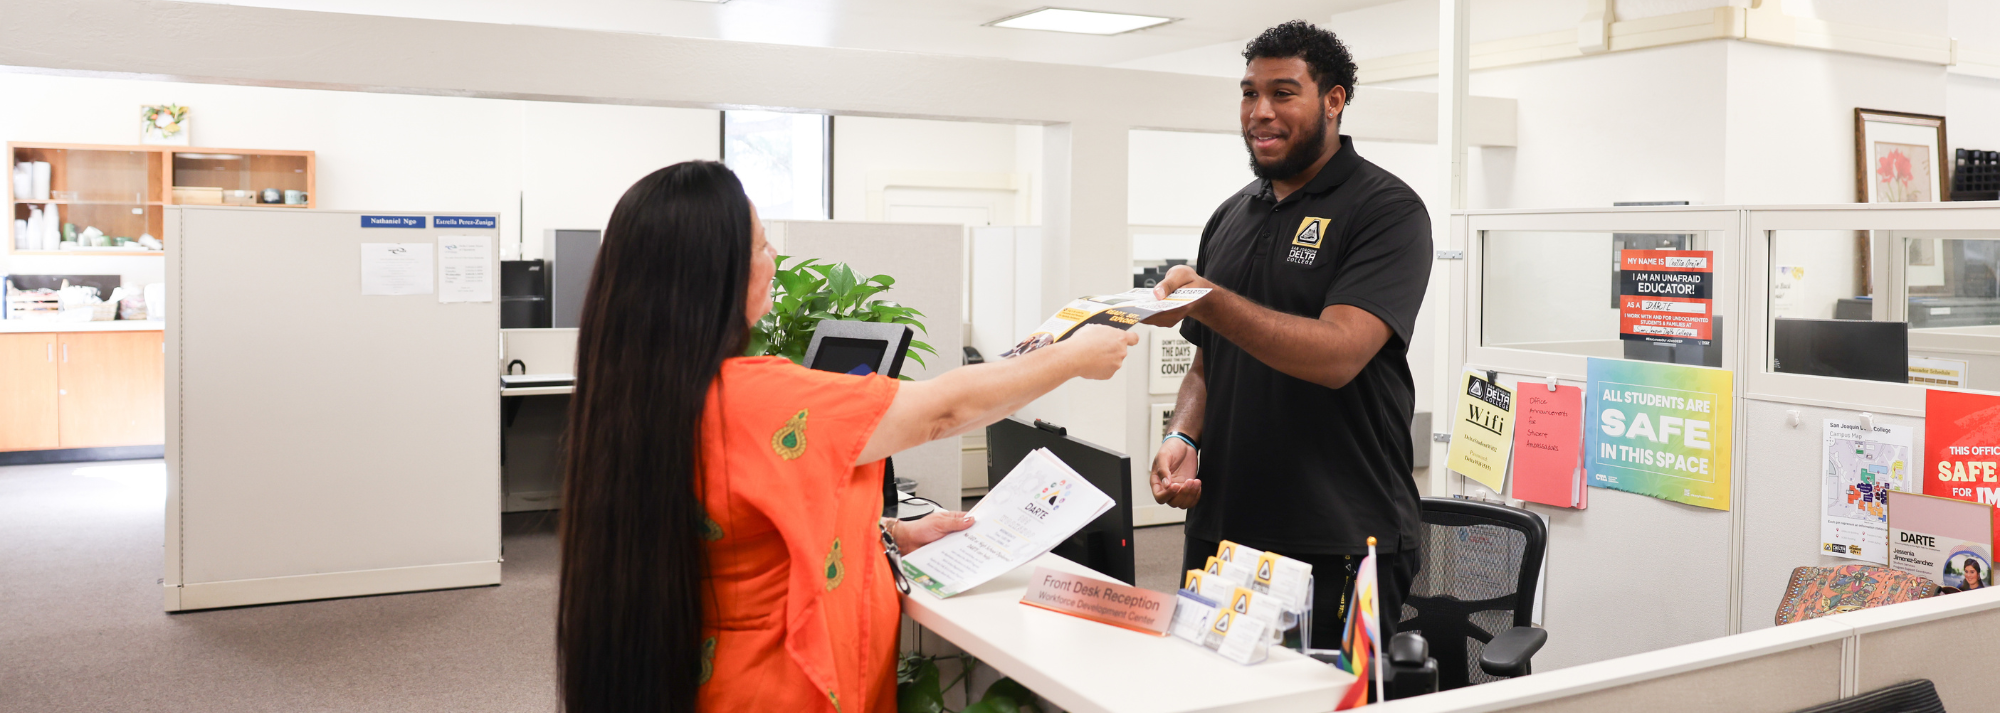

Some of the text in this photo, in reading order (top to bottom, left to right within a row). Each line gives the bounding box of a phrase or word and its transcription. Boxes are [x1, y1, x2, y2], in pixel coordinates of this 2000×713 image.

[370, 217, 417, 226] Nathaniel Ngo
[458, 219, 494, 227] Perez-Zuniga
[1287, 256, 1313, 265] COLLEGE
[1289, 249, 1316, 261] DELTA
[1627, 257, 1665, 266] MY NAME IS
[1636, 273, 1648, 281] AM
[1649, 273, 1660, 282] AN
[1661, 274, 1701, 283] UNAFRAID
[1638, 282, 1695, 295] EDUCATOR!
[1162, 346, 1191, 357] THE DAYS
[1161, 363, 1191, 375] COUNT
[1486, 387, 1510, 405] DELTA
[1602, 389, 1711, 413] ALL STUDENTS ARE
[1485, 396, 1509, 410] COLLEGE
[1469, 403, 1504, 433] Wifi
[1601, 408, 1711, 450] SAFE
[1829, 430, 1850, 438] Campus
[1873, 426, 1891, 434] College
[1949, 446, 2000, 456] THIS OFFIC
[1600, 442, 1709, 475] IN THIS SPACE
[1938, 460, 1998, 483] SAFE
[1952, 487, 2000, 508] FOR IM
[1024, 502, 1049, 520] DARTE
[1900, 531, 1935, 548] DARTE
[1043, 574, 1160, 611] Front Desk Reception
[1038, 590, 1155, 625] Workforce Development Center
